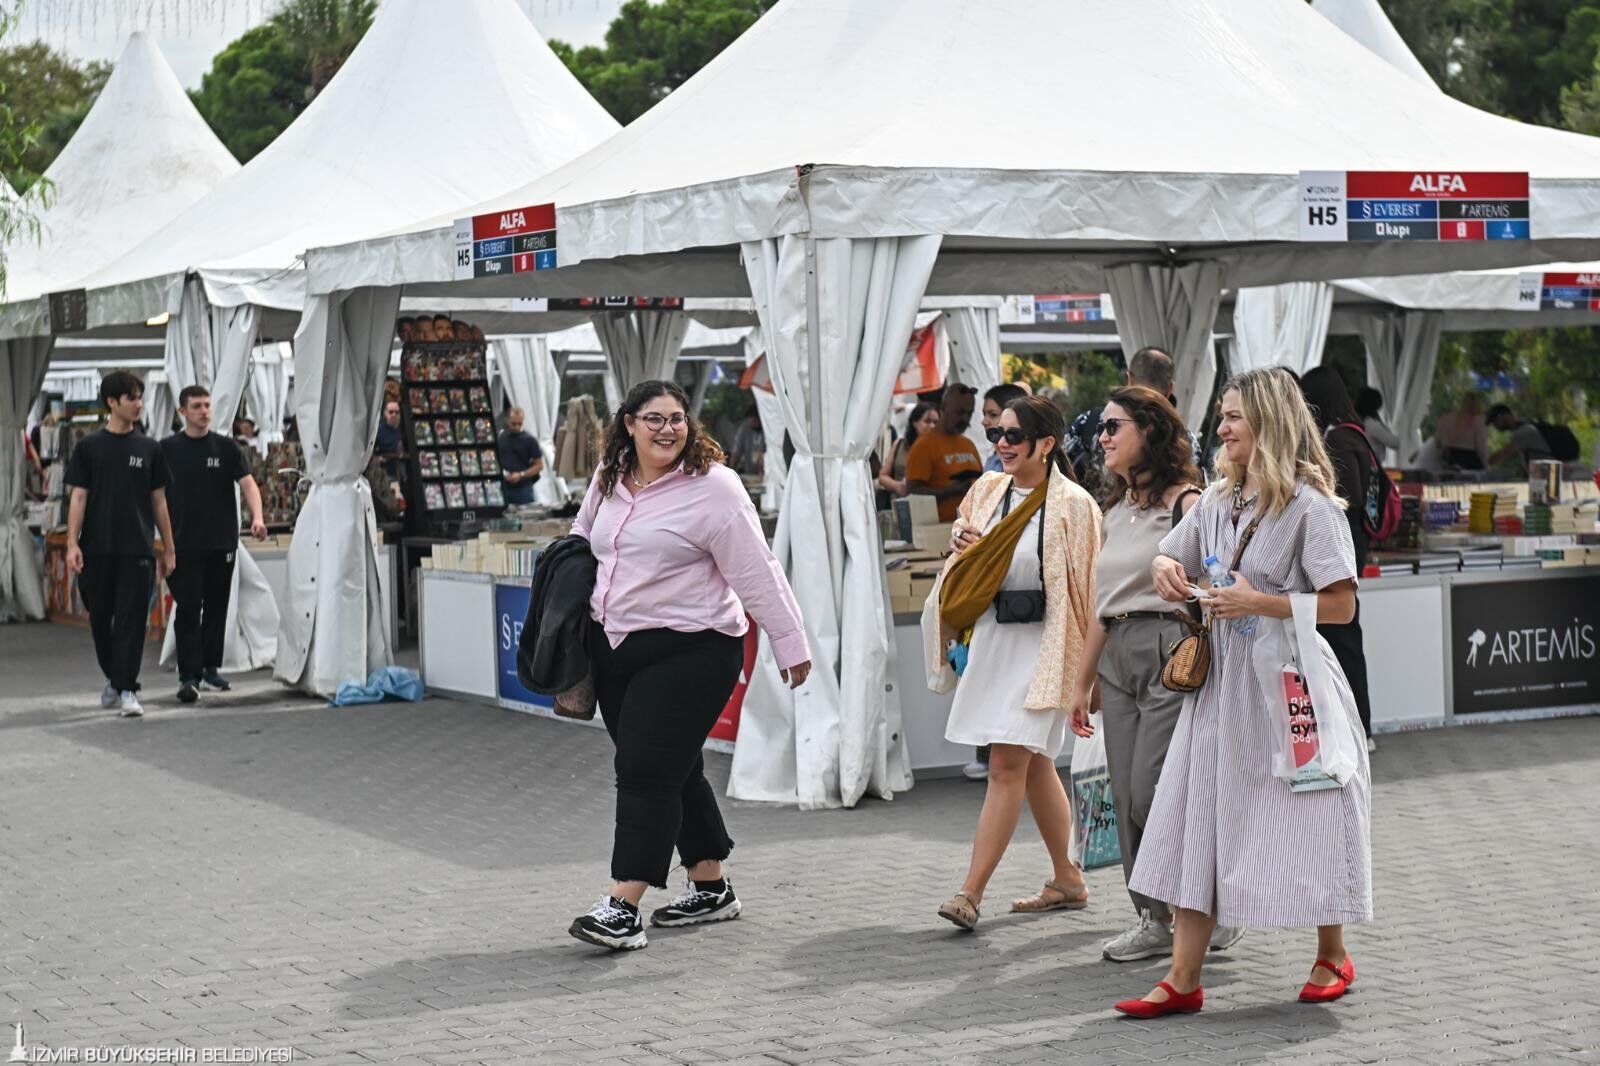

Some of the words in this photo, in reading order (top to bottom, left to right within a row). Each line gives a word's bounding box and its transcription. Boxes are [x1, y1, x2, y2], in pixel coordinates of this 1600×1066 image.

[1409, 174, 1467, 193] ALFA
[1308, 206, 1338, 226] H5
[1374, 203, 1422, 217] EVEREST
[500, 211, 526, 230] ALFA
[457, 248, 470, 267] H5
[129, 455, 143, 468] DK
